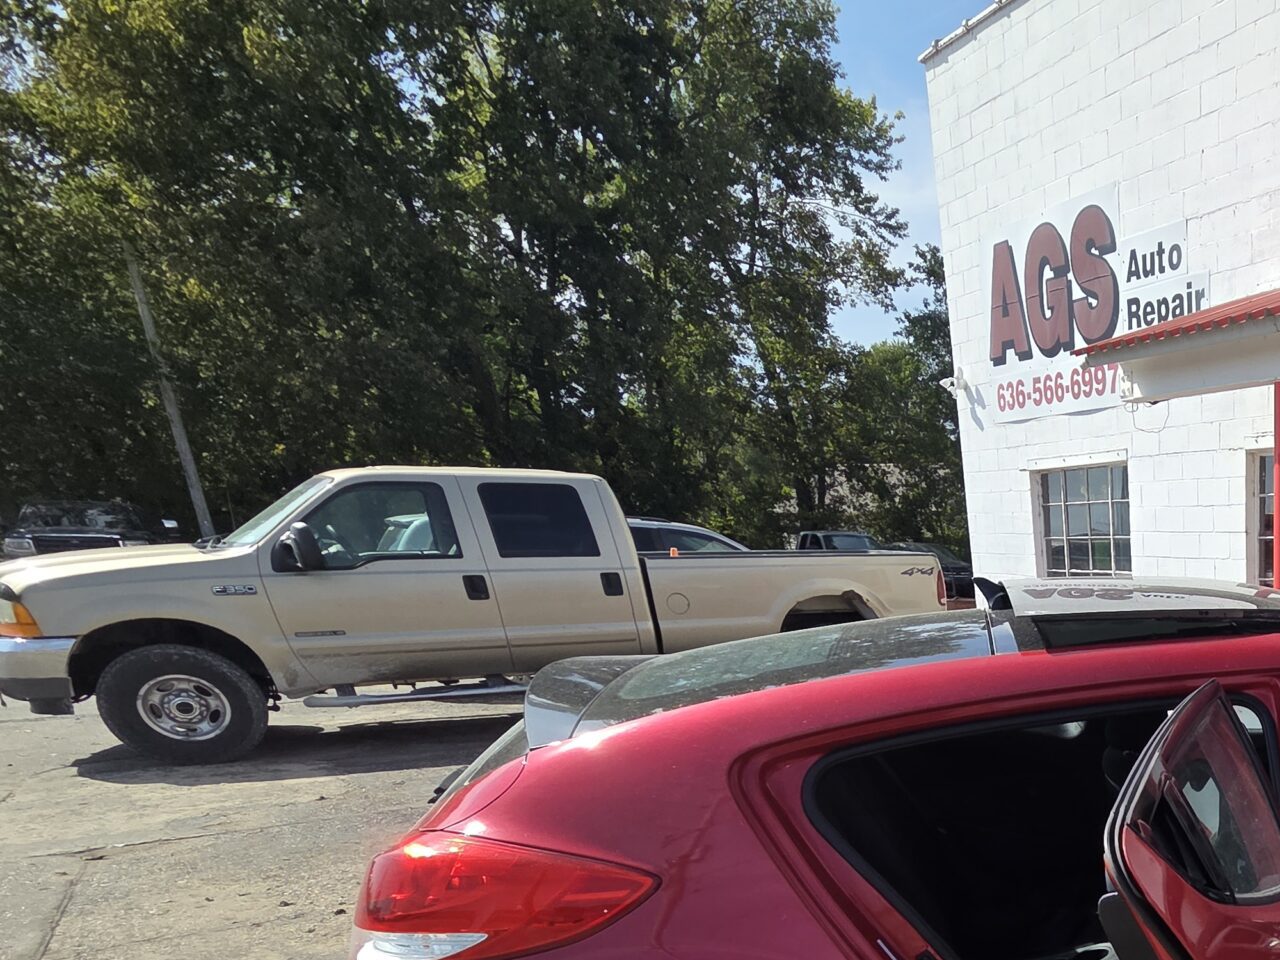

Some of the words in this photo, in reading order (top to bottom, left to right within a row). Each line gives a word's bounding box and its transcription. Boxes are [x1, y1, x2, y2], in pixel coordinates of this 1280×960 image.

[989, 204, 1120, 367] AGS
[1126, 241, 1183, 283] Auto
[1126, 281, 1205, 331] Repair
[997, 362, 1119, 412] 636-566-6997
